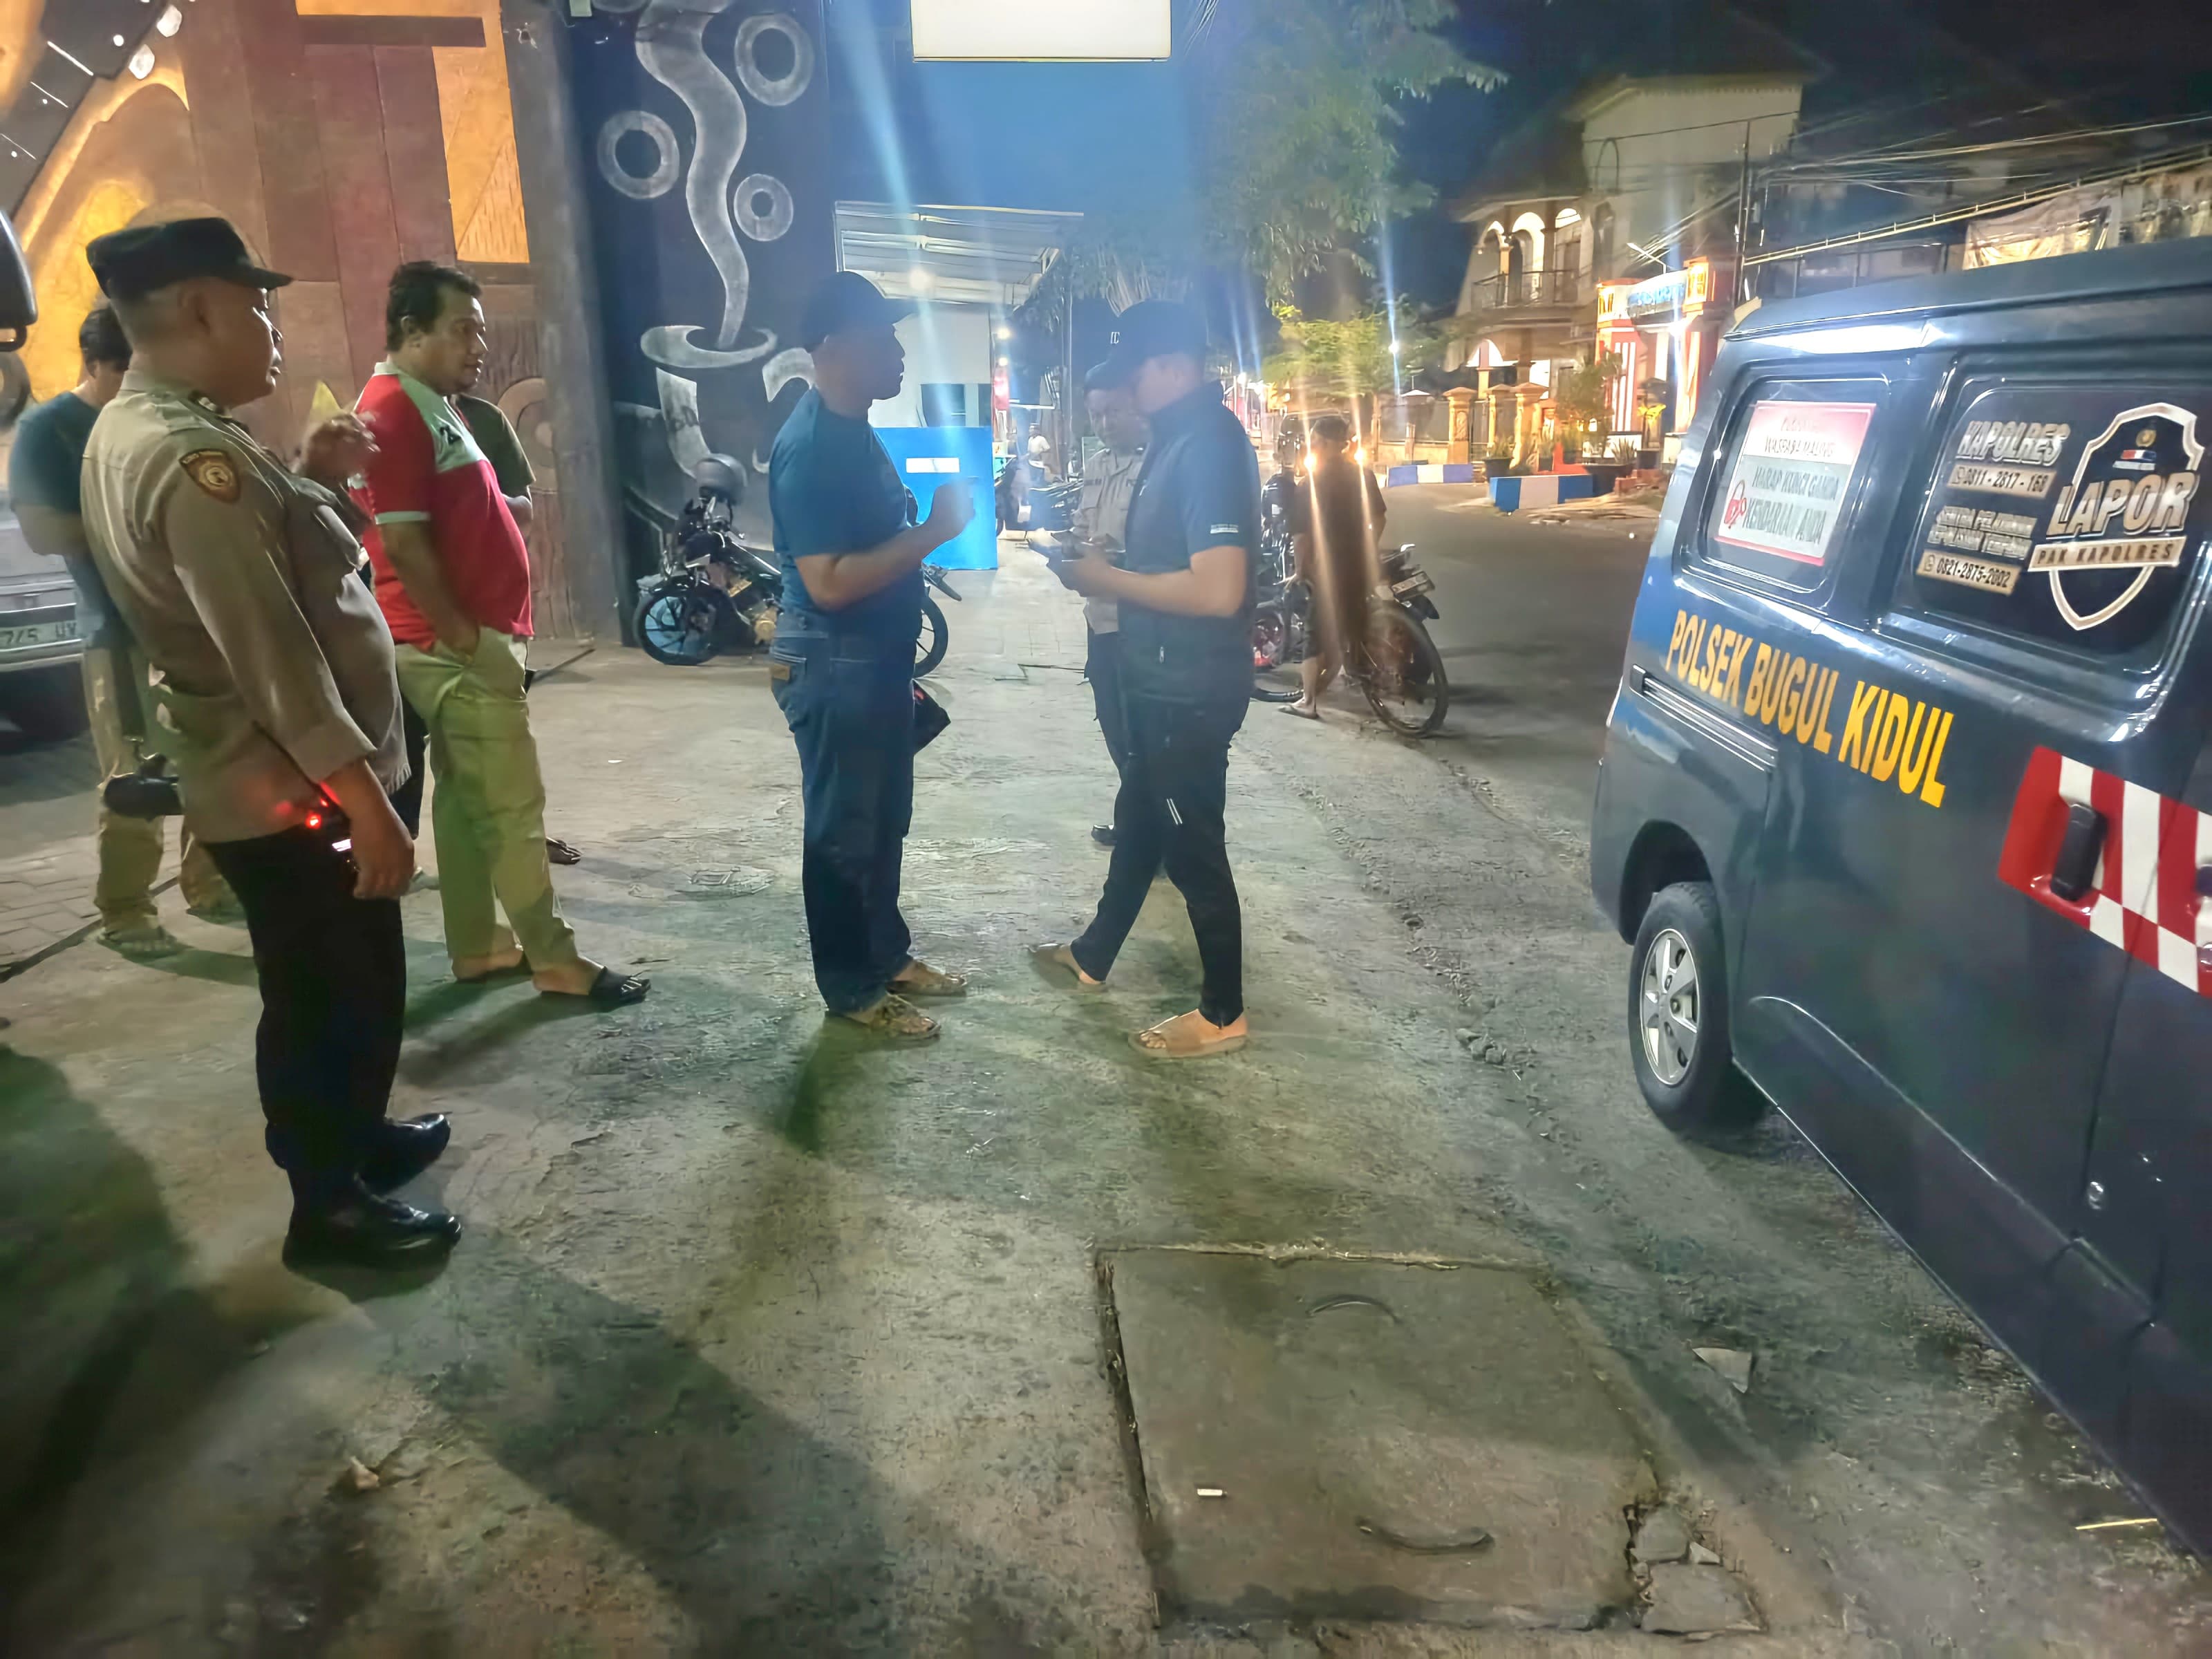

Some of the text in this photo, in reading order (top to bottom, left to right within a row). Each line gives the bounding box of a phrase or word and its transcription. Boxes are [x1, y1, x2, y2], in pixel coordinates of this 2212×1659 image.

[1956, 420, 2070, 466] KAPOLRES
[2046, 471, 2200, 539] LAPOR
[2038, 543, 2174, 565] PAK KAPOLRES
[1665, 609, 1954, 807] POLSEK BUGUL KIDUL
